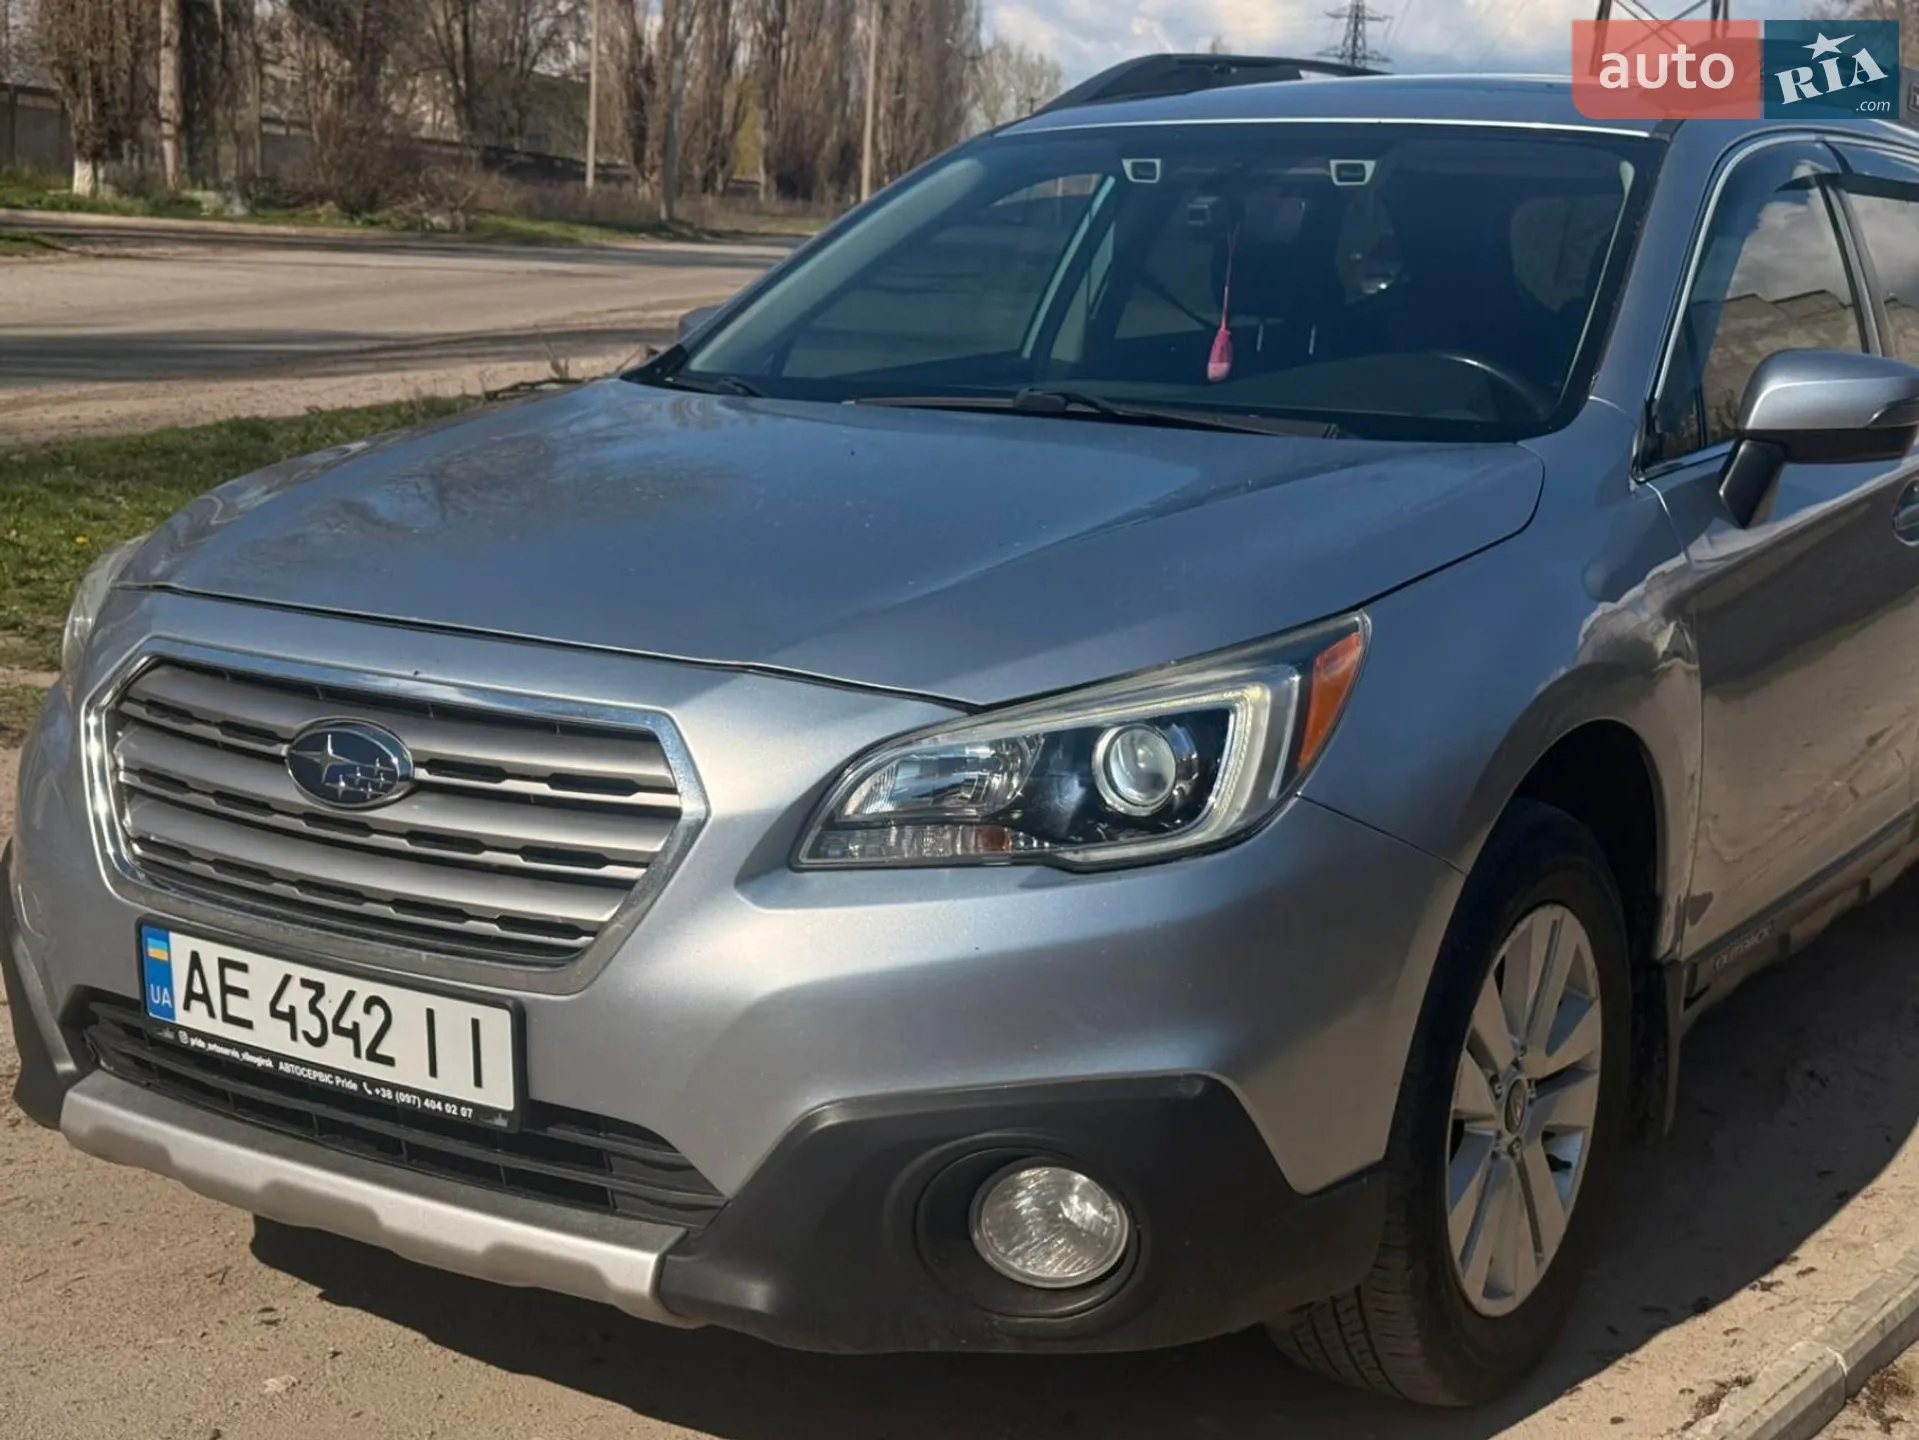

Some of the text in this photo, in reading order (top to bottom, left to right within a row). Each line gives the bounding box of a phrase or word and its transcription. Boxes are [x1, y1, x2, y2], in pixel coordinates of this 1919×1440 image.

[150, 983, 173, 1008] UA
[183, 950, 254, 1030] AE
[269, 973, 396, 1067] 4342
[335, 1075, 358, 1092] Pride
[375, 1087, 393, 1100] +38
[423, 1097, 443, 1112] 404
